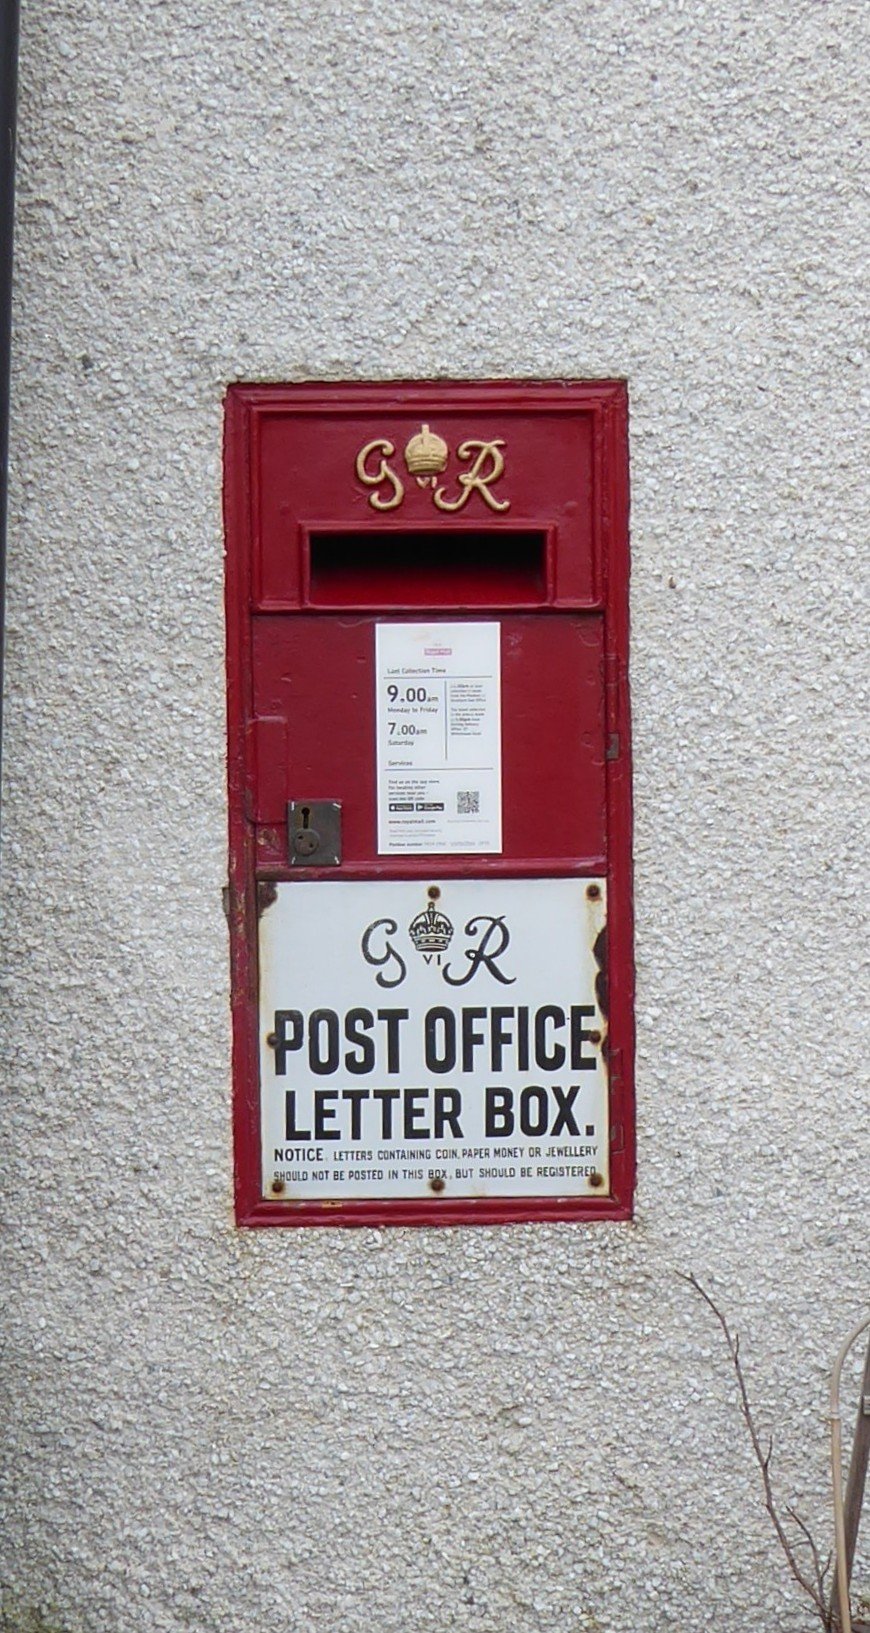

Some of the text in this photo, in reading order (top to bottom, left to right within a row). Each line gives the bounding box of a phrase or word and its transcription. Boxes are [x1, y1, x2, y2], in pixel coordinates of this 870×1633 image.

[356, 439, 404, 511] G
[433, 439, 511, 512] R
[361, 915, 517, 988] G VI R
[274, 1004, 597, 1076] POST OFFICE
[285, 1085, 595, 1142] LETTER BOX.
[273, 1170, 308, 1181] SHOULD
[312, 1170, 330, 1181] NOT
[333, 1170, 345, 1181] BE
[349, 1169, 384, 1181] POSTED
[388, 1169, 398, 1180] IN
[402, 1169, 424, 1180] THIS
[455, 1168, 474, 1179] BUT
[479, 1167, 516, 1178] SHOULD
[520, 1166, 533, 1178] BE
[333, 1150, 373, 1161] LETTERS
[377, 1149, 432, 1161] CONTAINING
[462, 1148, 491, 1159] PAPER
[493, 1146, 525, 1158] MONEY
[528, 1146, 542, 1158] OR
[545, 1145, 598, 1157] JEWELLERY
